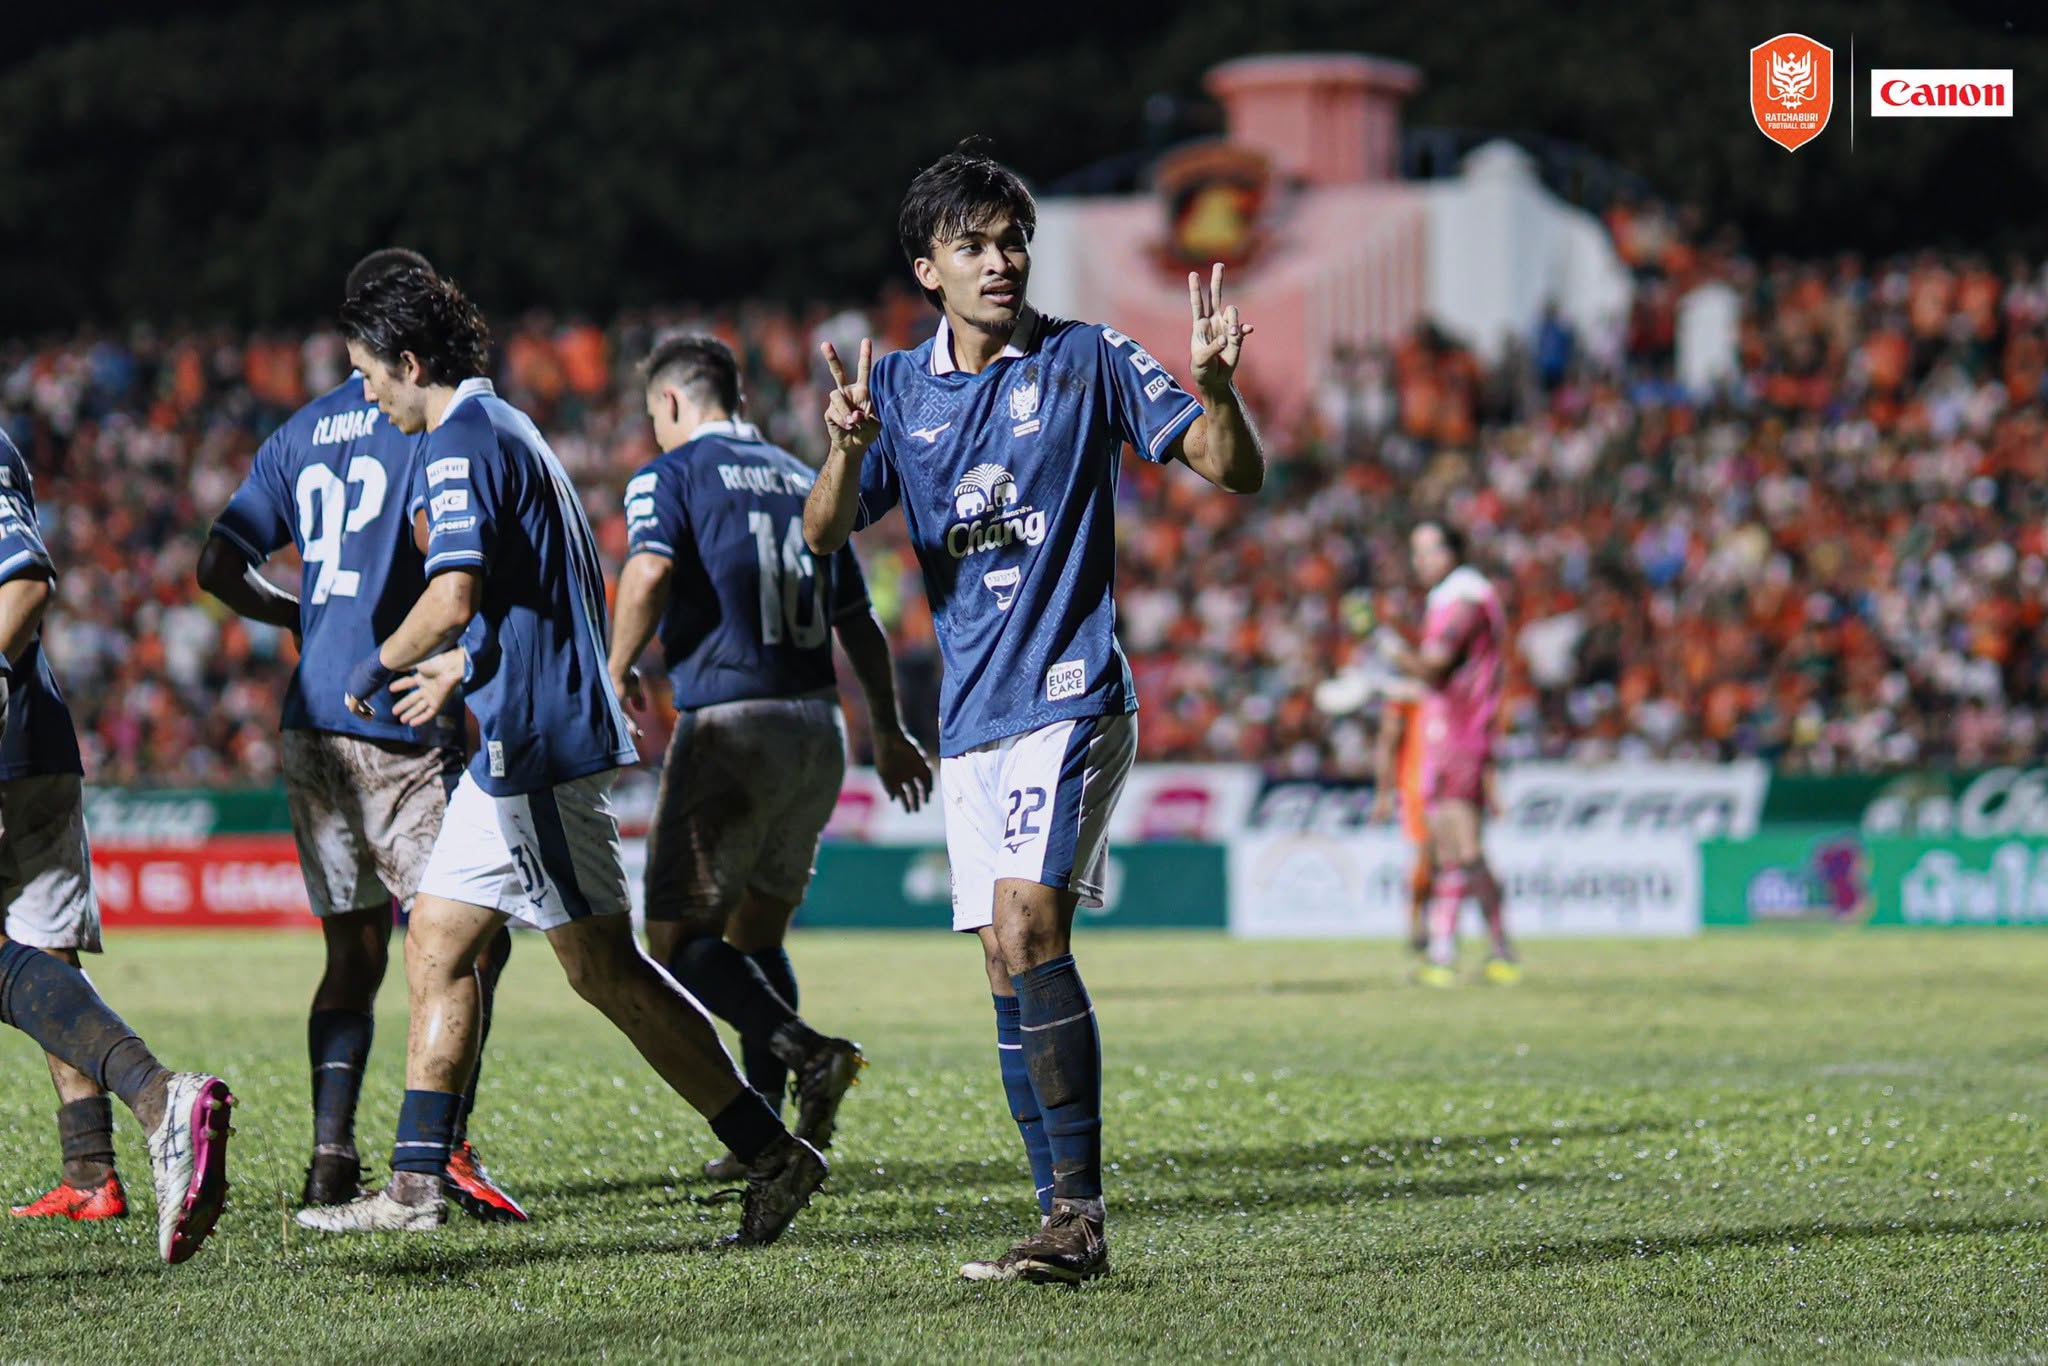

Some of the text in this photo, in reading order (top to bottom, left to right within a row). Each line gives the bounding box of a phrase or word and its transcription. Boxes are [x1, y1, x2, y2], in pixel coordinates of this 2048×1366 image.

[296, 455, 388, 605] 92
[947, 509, 1046, 560] Chang
[1049, 668, 1083, 687] EURO
[1049, 678, 1083, 697] CAKE
[1004, 787, 1046, 839] 22
[511, 844, 543, 891] 31
